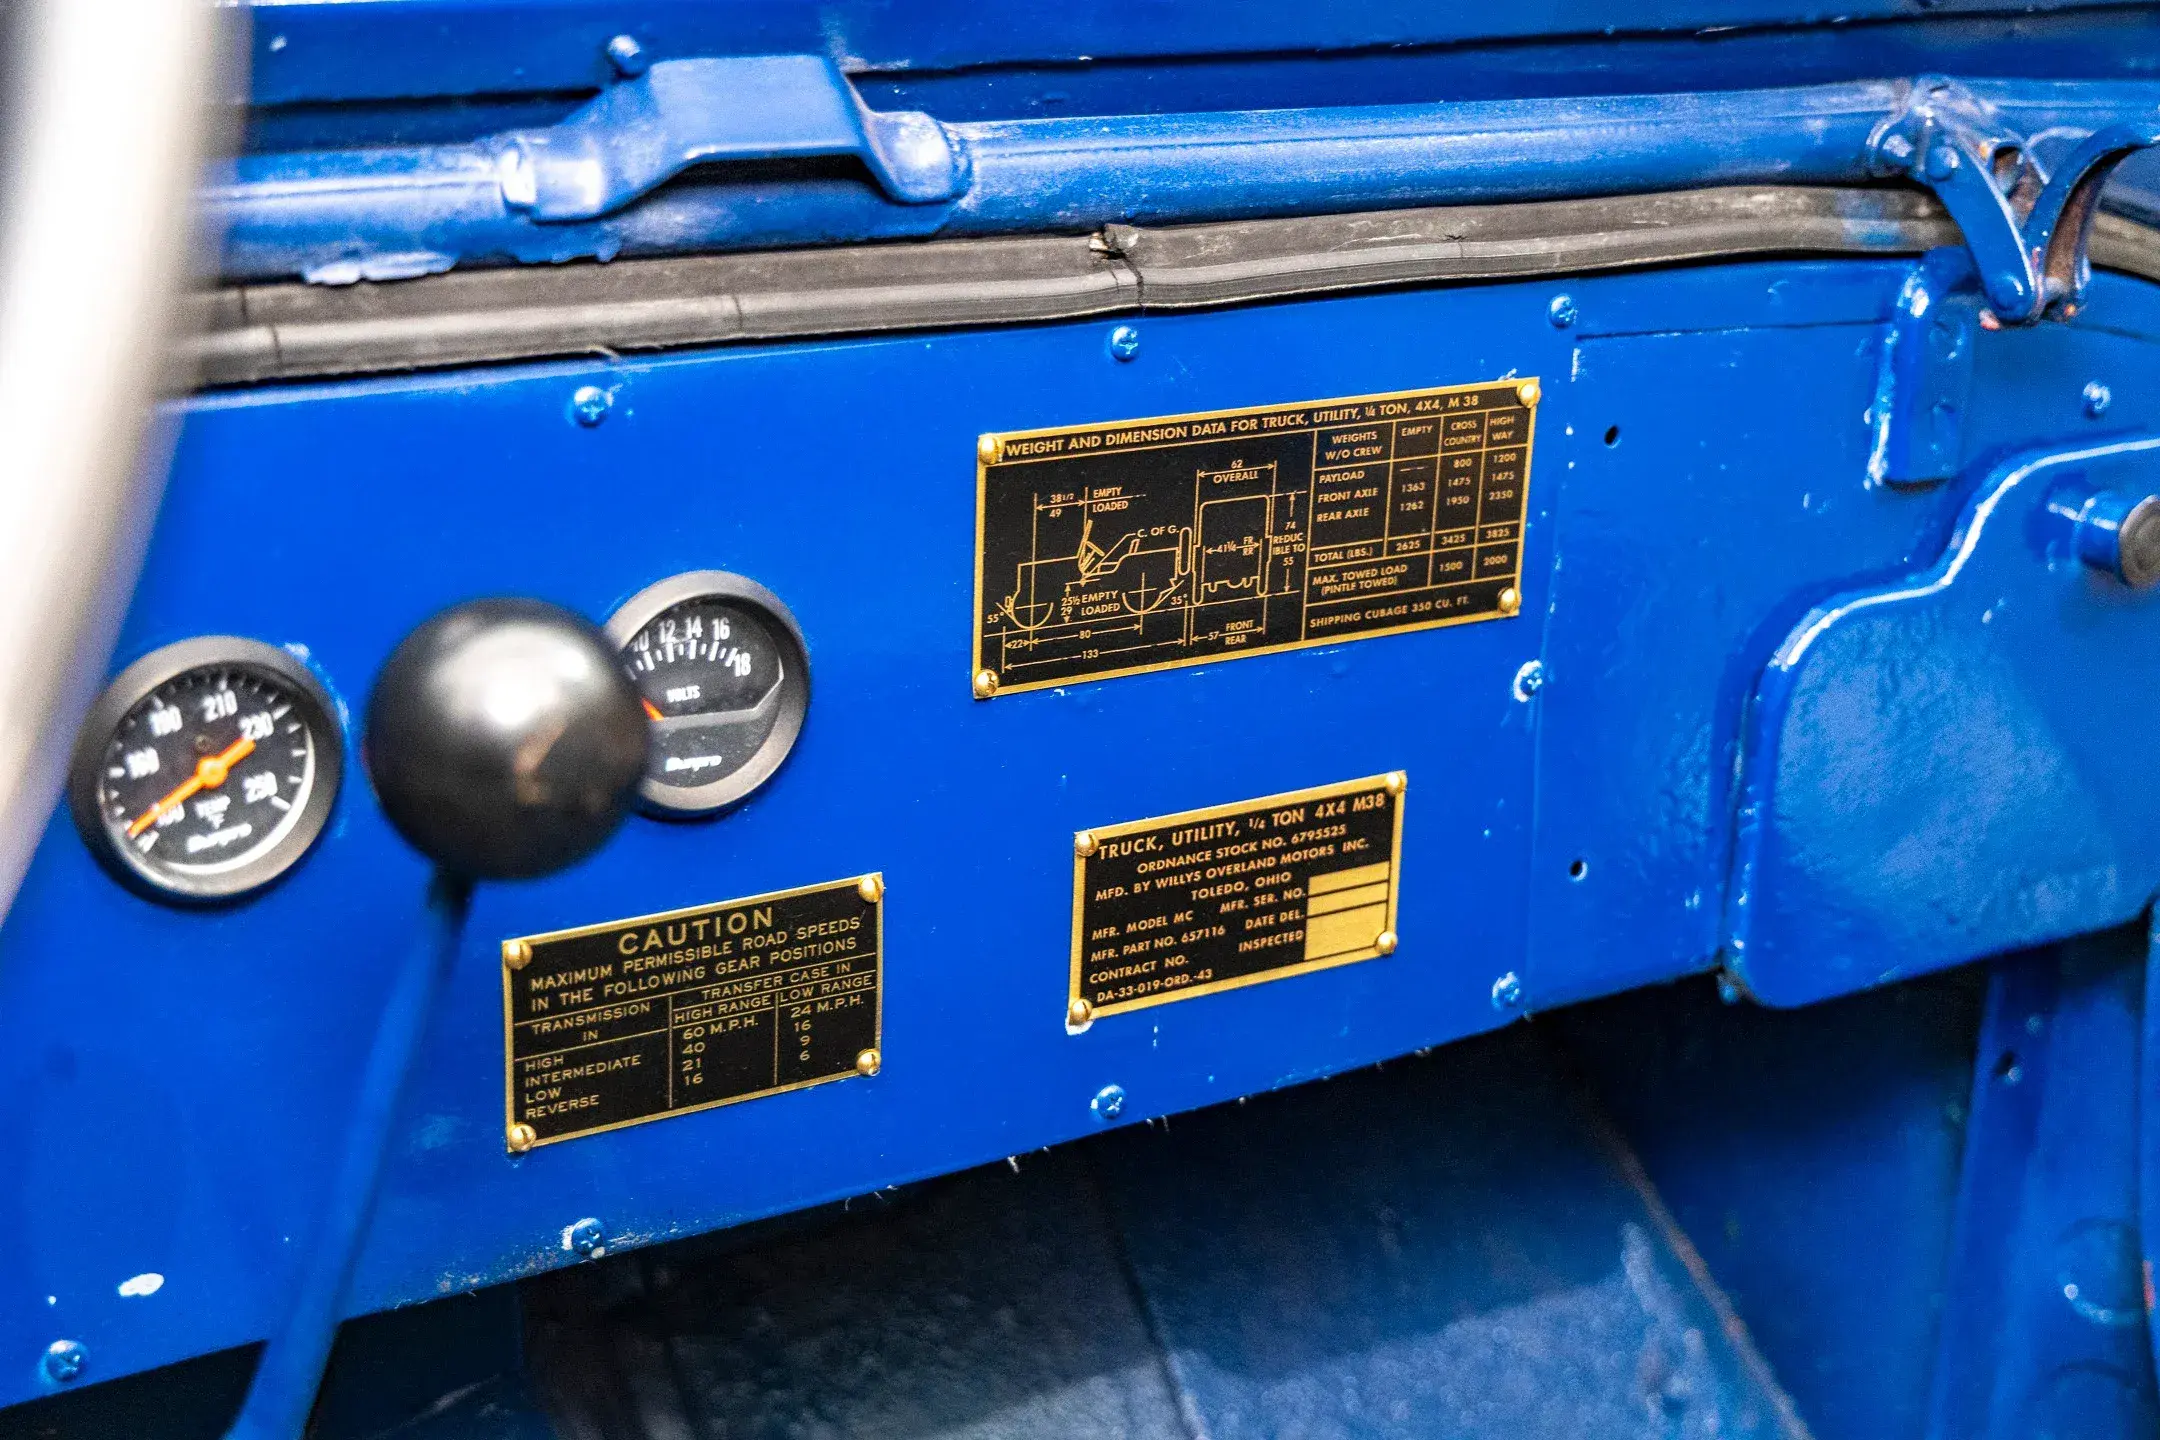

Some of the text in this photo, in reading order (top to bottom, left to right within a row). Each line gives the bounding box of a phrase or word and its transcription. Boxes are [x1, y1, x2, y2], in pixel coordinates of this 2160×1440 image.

[1007, 440, 1064, 456] WEIGHT
[1069, 436, 1101, 449] AND
[1106, 427, 1187, 445] DIMENSION
[1191, 422, 1226, 436] DATA
[1231, 419, 1258, 432] FOR
[1262, 413, 1309, 428] TRUCK,
[1314, 408, 1362, 424] UTILITY,
[1380, 403, 1410, 416] TON,
[1415, 400, 1443, 412] 4X4,
[1448, 397, 1461, 408] M
[1462, 396, 1478, 406] 38
[1451, 420, 1477, 431] CROSS
[1490, 416, 1514, 426] HIGH
[1332, 431, 1378, 444] WEIGHTS
[1401, 425, 1433, 437] EMPTY
[1492, 431, 1513, 440] WAY
[1444, 434, 1482, 447] COUNTRY
[1325, 446, 1382, 461] W/O CREW
[1493, 452, 1516, 463] 1200
[1231, 460, 1243, 469] 62
[1453, 458, 1472, 468] 800
[1213, 470, 1258, 484] OVERALL
[1319, 470, 1365, 484] PAYLOAD
[1448, 476, 1471, 487] 1475
[1492, 471, 1515, 482] 1475
[1093, 487, 1122, 498] EMPTY
[1402, 482, 1425, 492] 1363
[1318, 488, 1378, 503] FRONT AXLE
[1446, 496, 1470, 506] 1950
[1489, 490, 1513, 500] 2350
[1092, 500, 1128, 513] LOADED
[1400, 500, 1424, 512] 1262
[1049, 508, 1062, 518] 49
[1316, 507, 1370, 522] REAR AXLE
[1137, 525, 1180, 538] C. OF G.
[1285, 521, 1296, 530] 74
[1441, 534, 1466, 545] 3425
[1486, 528, 1510, 538] 3825
[1243, 536, 1254, 545] FR
[1396, 540, 1421, 551] 2625
[1243, 546, 1254, 555] RR
[1290, 543, 1305, 553] TO
[1314, 546, 1372, 562] TOTAL (LBS.)
[1283, 556, 1294, 566] 55
[1439, 561, 1462, 572] 1500
[1483, 555, 1508, 565] 2000
[1312, 564, 1408, 586] MAX. TOWED LOAD
[1322, 582, 1357, 596] (PINTLE
[1081, 590, 1118, 604] EMPTY
[1060, 602, 1121, 616] 29 LOADED
[1310, 611, 1360, 628] SHIPPING
[1364, 605, 1407, 620] CUBAGE
[1411, 601, 1431, 612] 350
[1435, 598, 1453, 609] CU.
[659, 620, 676, 643] 12
[685, 616, 702, 638] 14
[712, 617, 730, 640] 16
[1226, 619, 1254, 631] FRONT
[1079, 629, 1092, 639] 80
[1207, 631, 1219, 641] 57
[1225, 634, 1246, 645] REAR
[1011, 639, 1024, 649] 22
[1081, 649, 1099, 659] 133
[734, 652, 751, 676] 18
[667, 686, 700, 702] VOLTS
[202, 690, 237, 722] 210
[1099, 839, 1164, 860] TRUCK,
[1172, 821, 1239, 845] UTILITY,
[1273, 809, 1304, 827] TON
[1315, 801, 1346, 818] 4X4
[1352, 793, 1385, 812] M38
[1136, 824, 1347, 874] ORDNANCE STOCK NO. 6795525
[1095, 838, 1369, 900] MFD. BY WILLYS OVERLAND MOTORS INC.
[1191, 872, 1291, 901] TOLEDO, OHIO
[1219, 887, 1306, 914] MFR. SER. NO.
[1092, 910, 1193, 940] MFR. MODEL MC
[1245, 908, 1304, 929] DATE DEL.
[619, 907, 773, 955] CAUTION
[1090, 925, 1225, 962] MFR. PART NO. 657116
[1239, 930, 1304, 952] INSPECTED
[531, 917, 861, 990] MAXIMUM PERMISSIBLE ROAD SPEEDS
[532, 937, 857, 1011] IN THE FOLLOWING GEAR POSITIONS
[1089, 954, 1189, 984] CONTRACT NO.
[702, 962, 851, 1000] TRANSFER CASE IN
[780, 975, 872, 1002] LOW RANGE
[675, 996, 770, 1024] HIGH RANGE
[790, 995, 864, 1017] 24 M.P.H.
[532, 1002, 651, 1035] TRANSMISSION
[683, 1017, 759, 1039] 60 M.P.H.
[794, 1020, 812, 1031] 16
[583, 1029, 598, 1041] IN
[800, 1035, 810, 1047] 9
[682, 1042, 705, 1053] 40
[800, 1050, 810, 1061] 6
[525, 1055, 564, 1071] HIGH
[682, 1058, 701, 1070] 21
[525, 1055, 642, 1087] INTERMEDIATE
[684, 1072, 703, 1085] 16
[525, 1087, 562, 1103] LOW
[526, 1095, 599, 1119] REVERSE
